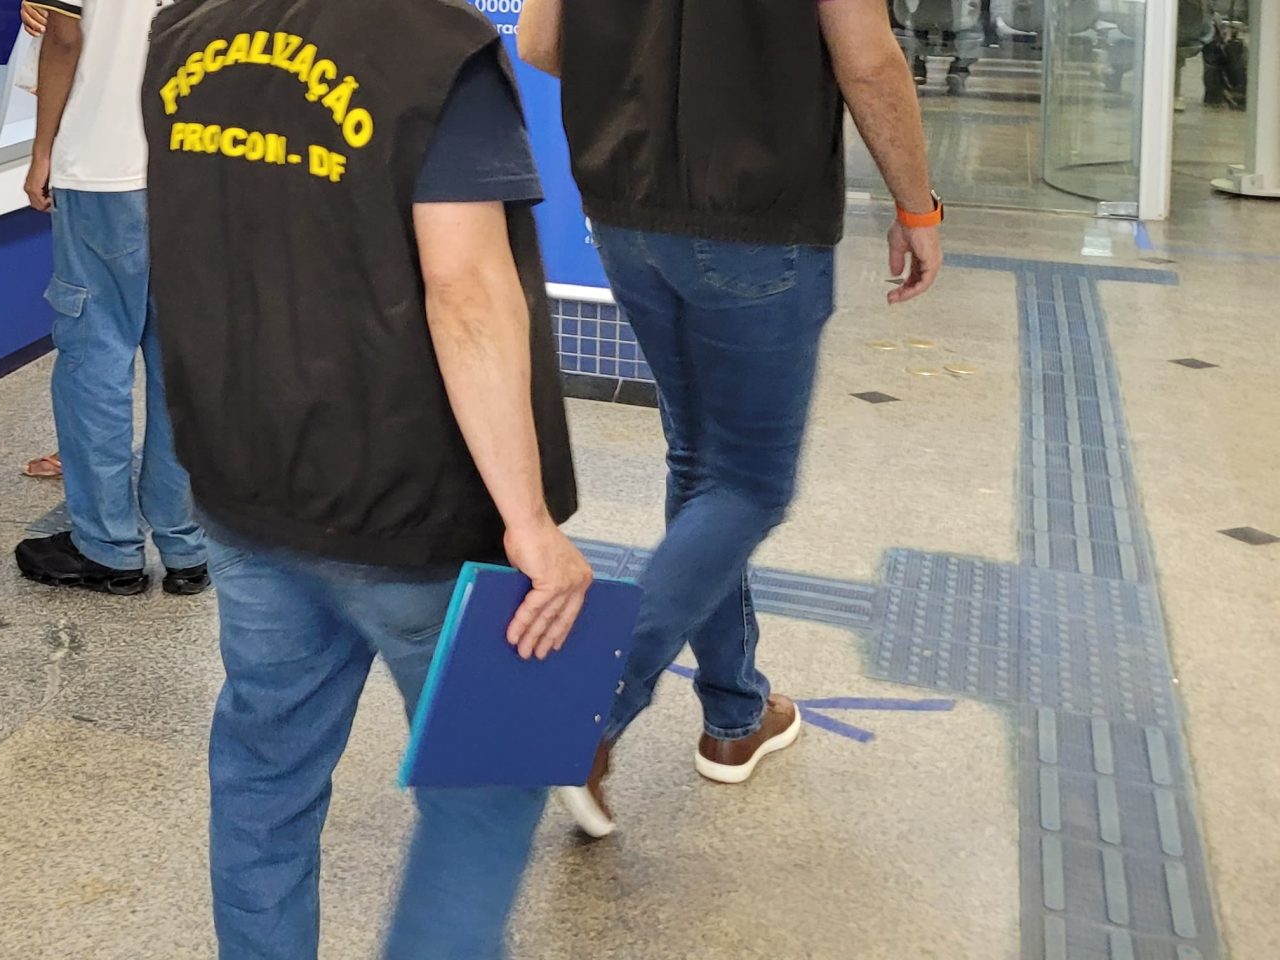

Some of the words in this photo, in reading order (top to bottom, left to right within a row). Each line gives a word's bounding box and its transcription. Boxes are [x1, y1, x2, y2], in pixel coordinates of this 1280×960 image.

[160, 30, 374, 148] FISCALIZAÇÃO
[170, 122, 287, 165] PROCON
[308, 144, 348, 183] DF
